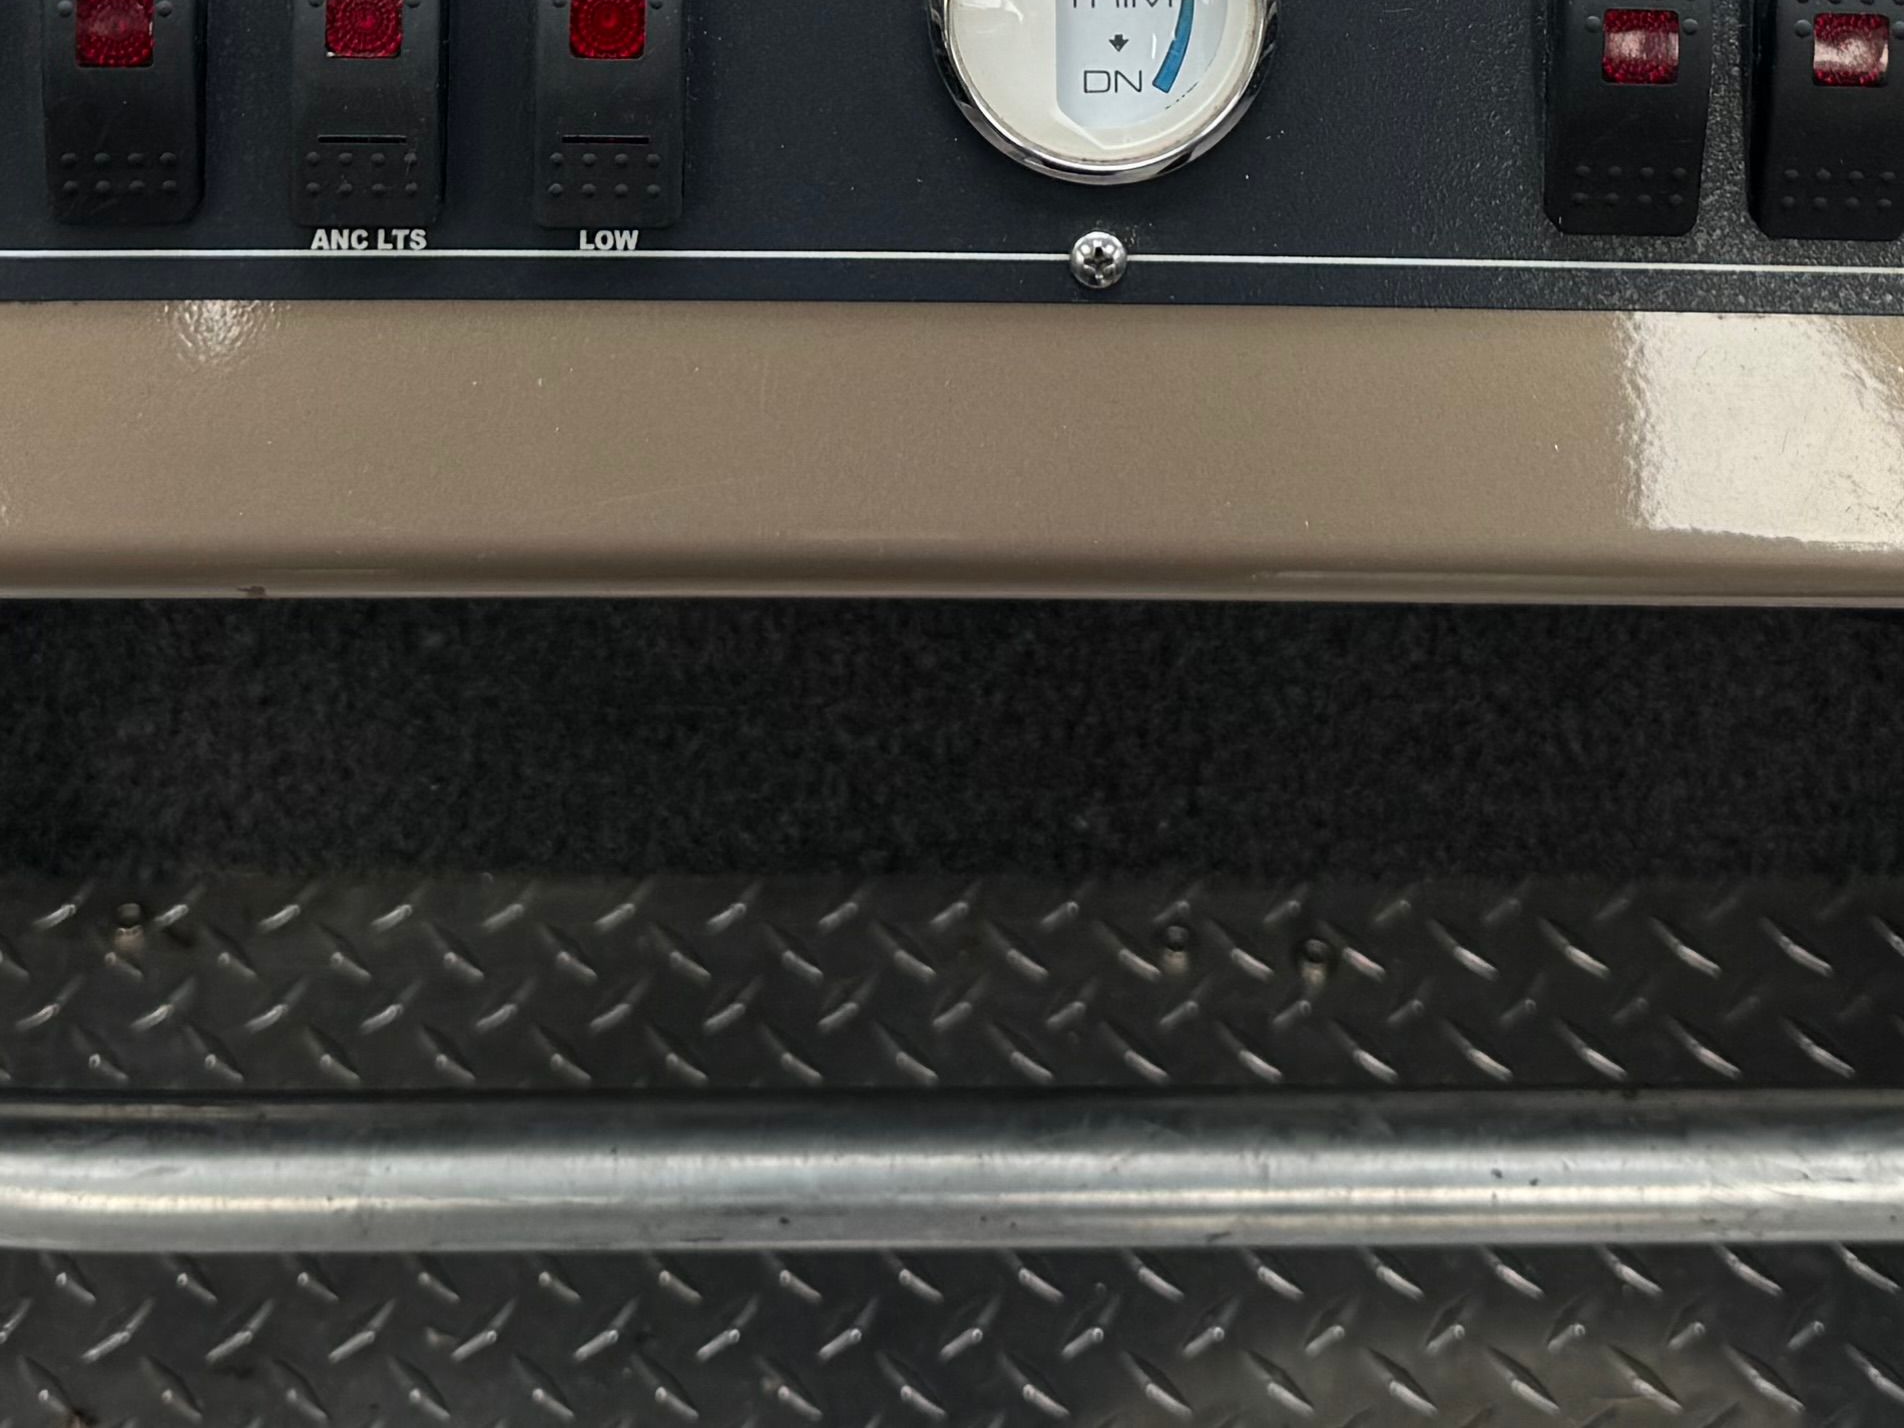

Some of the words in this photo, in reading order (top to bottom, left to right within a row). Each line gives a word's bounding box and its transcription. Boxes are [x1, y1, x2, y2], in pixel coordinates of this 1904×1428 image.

[1083, 69, 1143, 93] DN
[311, 229, 369, 250] ANC
[377, 229, 427, 250] LTS
[580, 229, 639, 250] LOW
